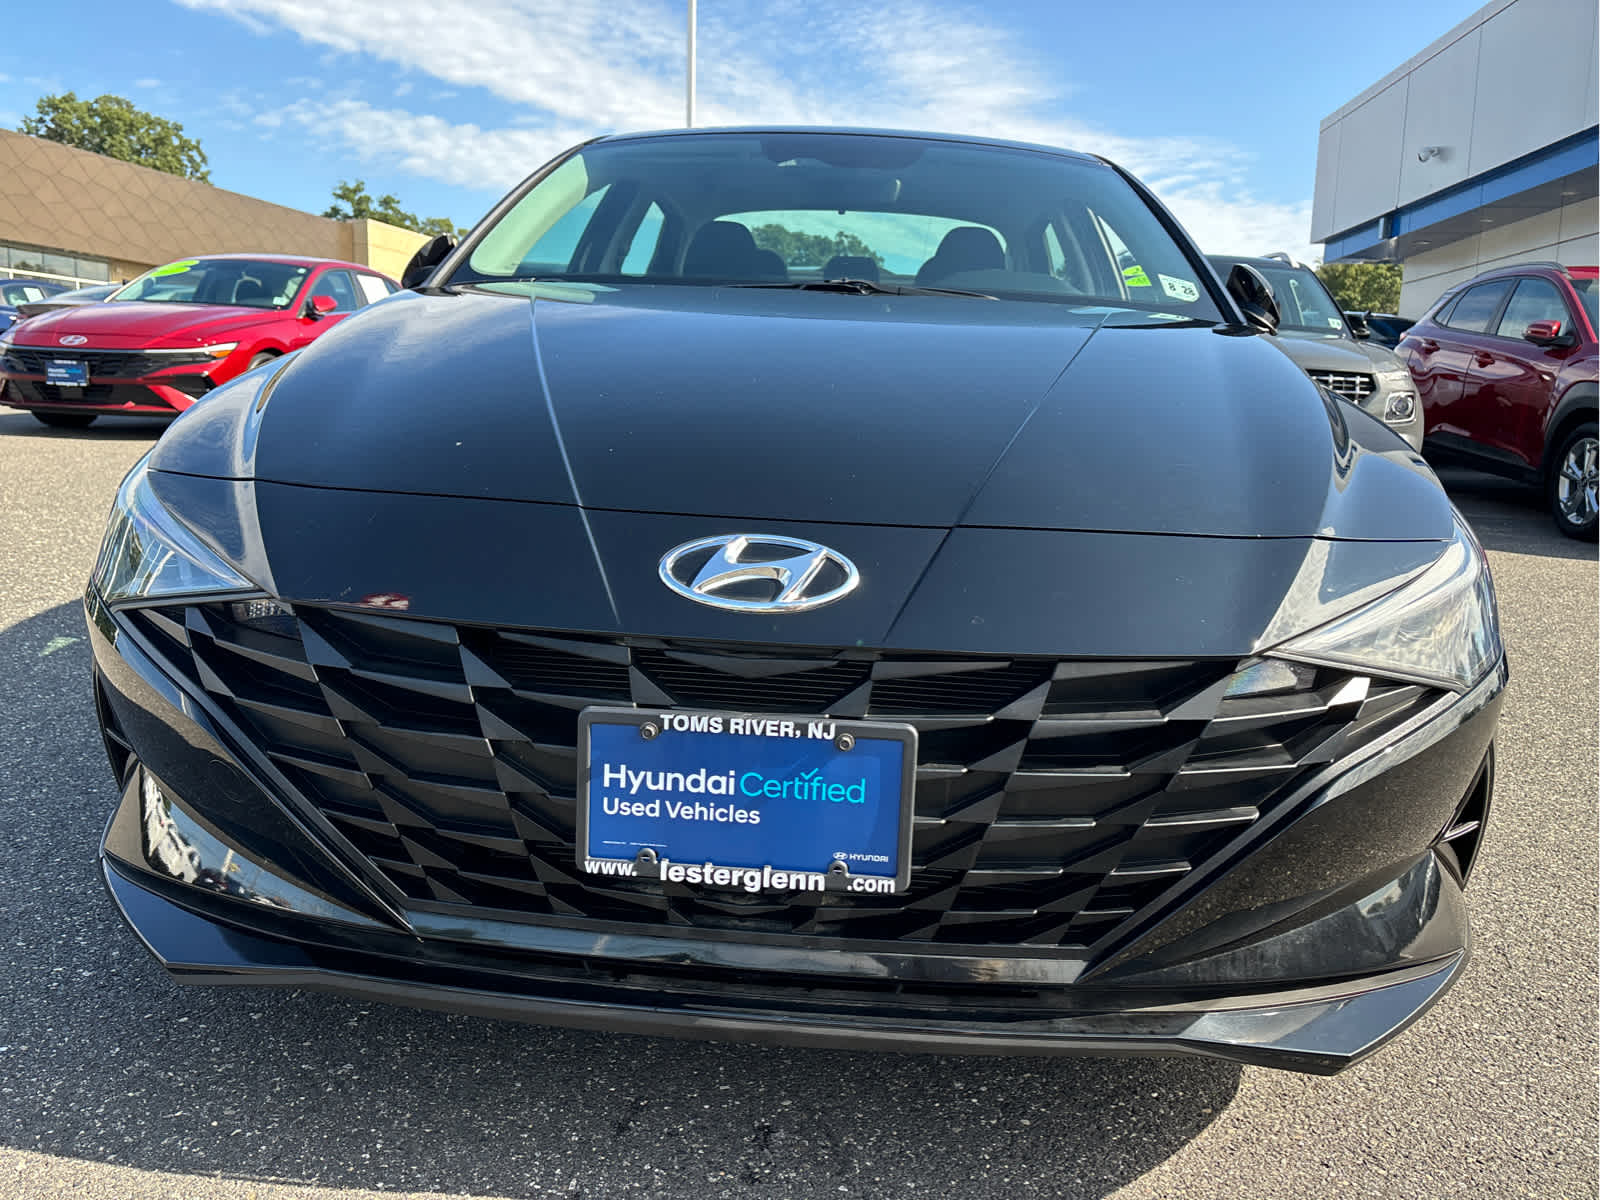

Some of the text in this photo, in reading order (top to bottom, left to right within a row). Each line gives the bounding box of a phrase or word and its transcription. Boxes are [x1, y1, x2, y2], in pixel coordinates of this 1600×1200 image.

[660, 714, 836, 740] TOMS RIVER, NJ
[603, 763, 866, 803] Hyundai Certified
[603, 797, 760, 824] Used Vehicles
[849, 853, 889, 863] HYUNDAI
[584, 859, 896, 893] www. lesterglenn .com
